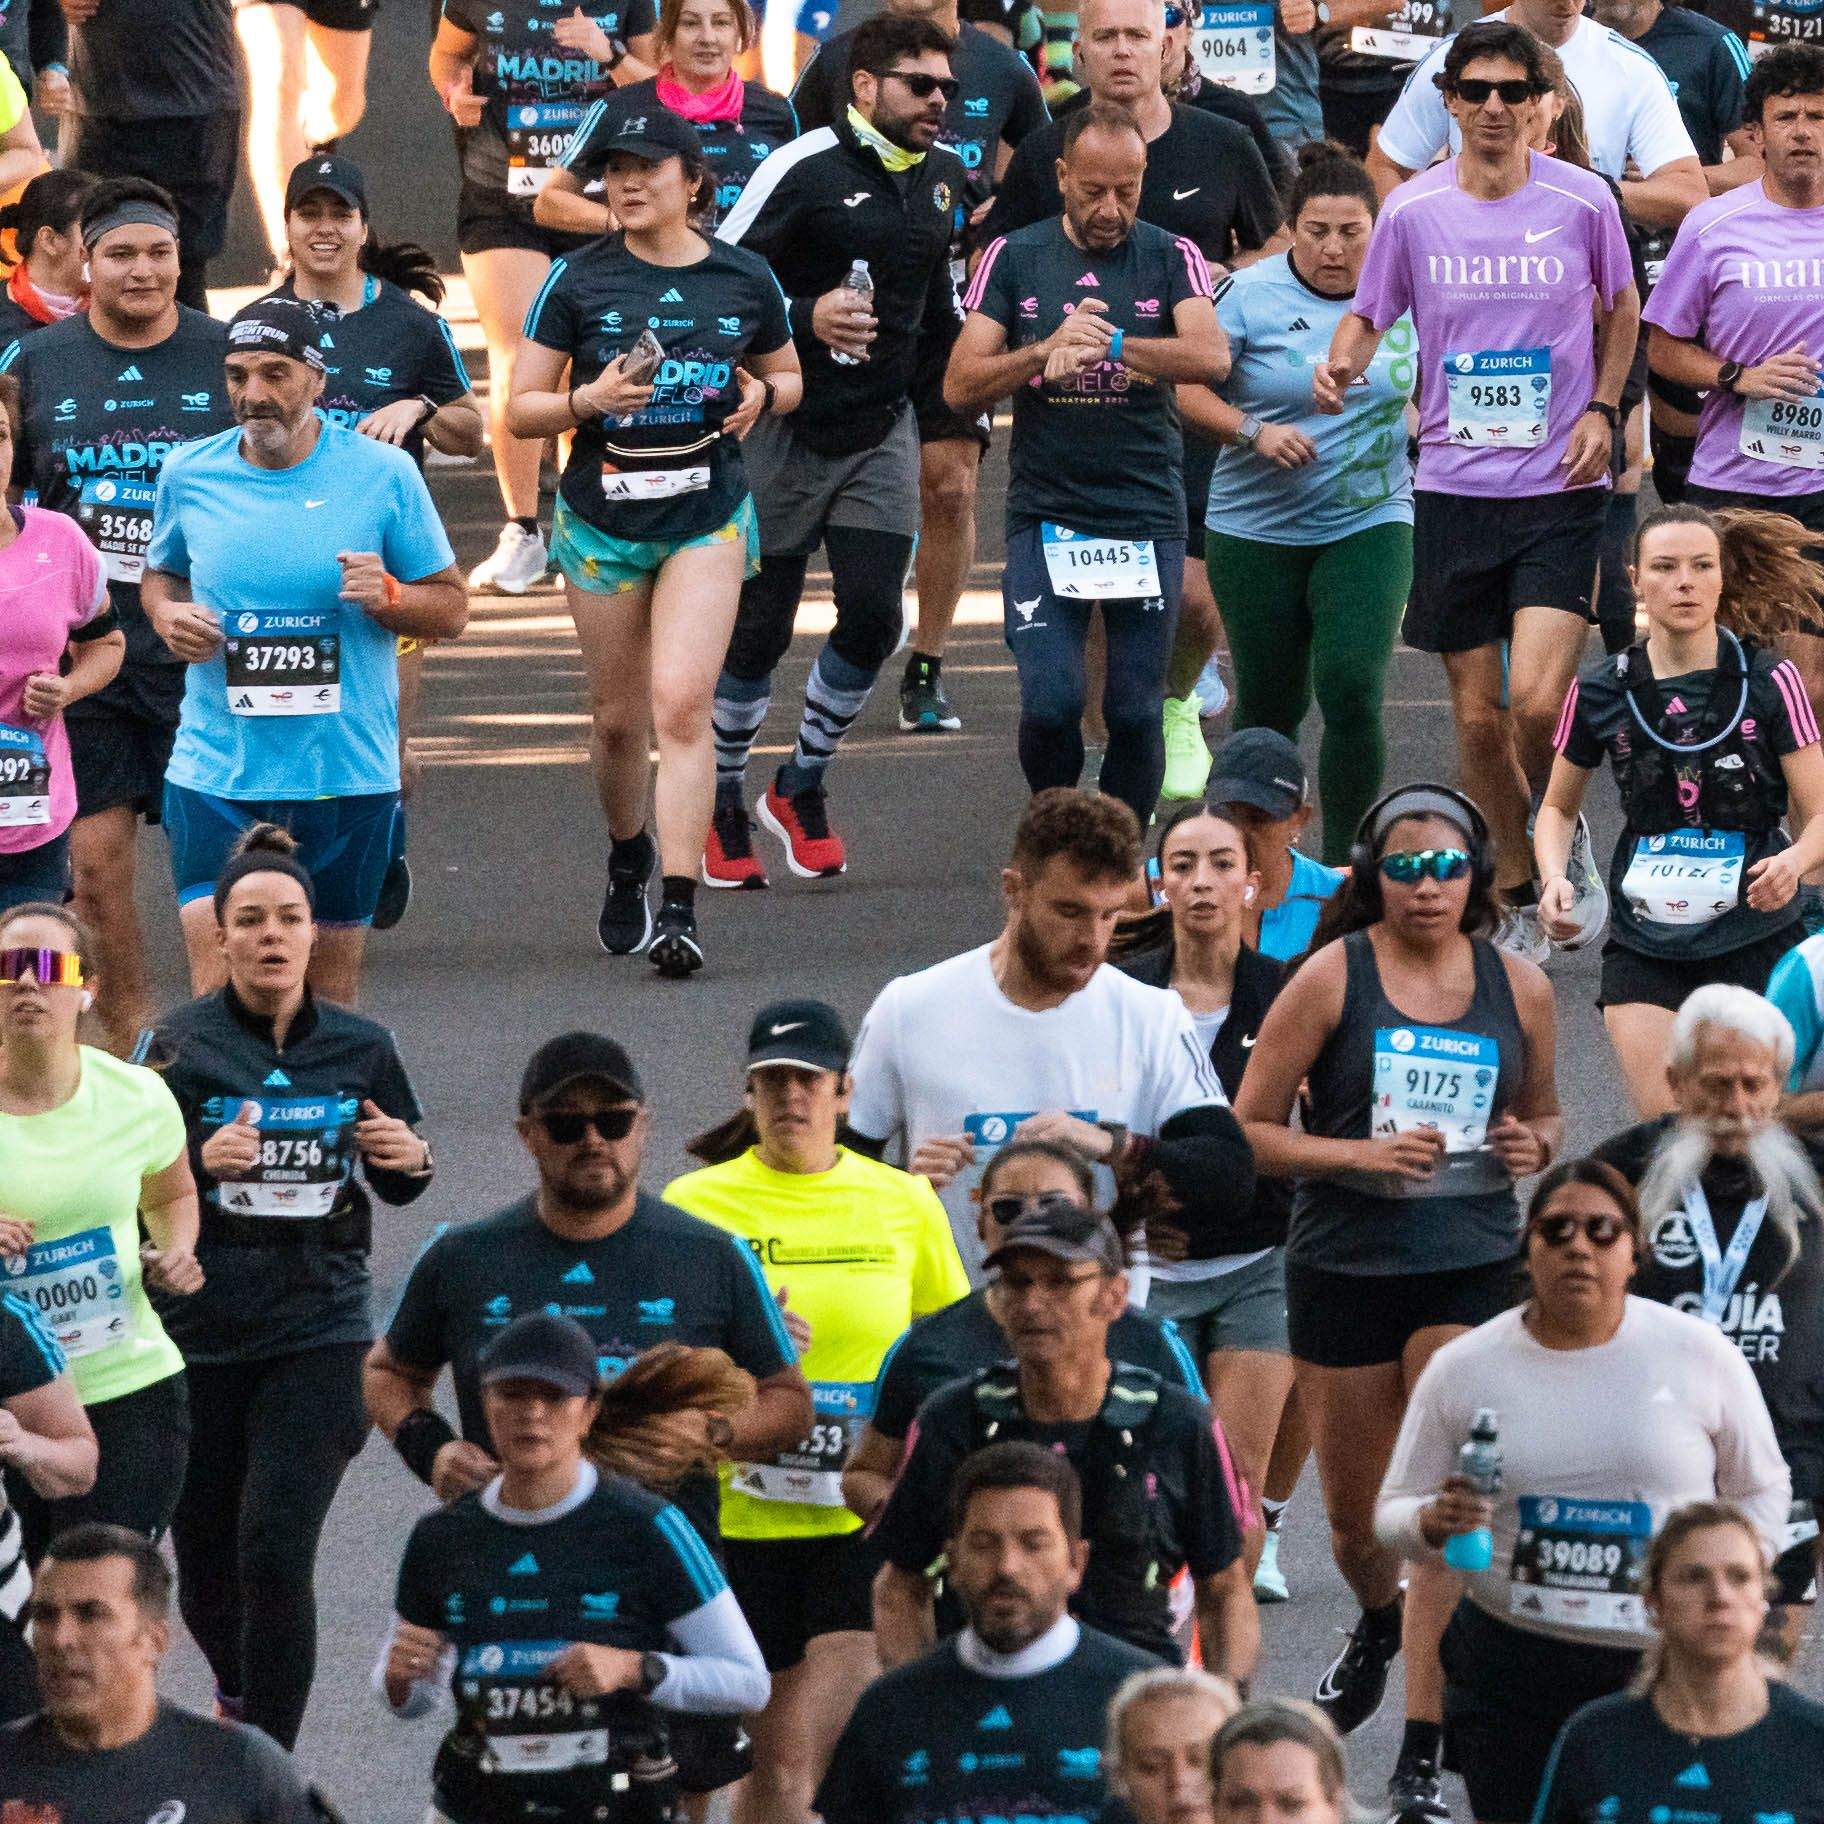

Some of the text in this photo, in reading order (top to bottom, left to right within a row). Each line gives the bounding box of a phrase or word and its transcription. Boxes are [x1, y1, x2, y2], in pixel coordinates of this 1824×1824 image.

[1209, 11, 1258, 24] ZURICH
[1769, 15, 1823, 37] 35121
[1202, 38, 1246, 58] 9064
[1428, 250, 1564, 287] marro
[664, 319, 694, 328] ZURICH
[1480, 354, 1532, 371] ZURICH
[120, 398, 154, 409] ZURICH
[1471, 386, 1521, 408] 9583
[639, 412, 692, 427] ZURICH
[1771, 402, 1822, 427] 8980
[1793, 428, 1821, 441] MARRO
[1069, 546, 1130, 569] 10445
[264, 614, 320, 629] ZURICH
[246, 647, 316, 671] 37293
[1671, 834, 1725, 852] ZURICH
[1421, 1036, 1480, 1056] ZURICH
[1406, 1068, 1462, 1098] 9175
[269, 1105, 326, 1122] ZURICH
[33, 1239, 95, 1268] ZURICH
[1537, 1543, 1621, 1575] 39089
[491, 1687, 573, 1722] 37454
